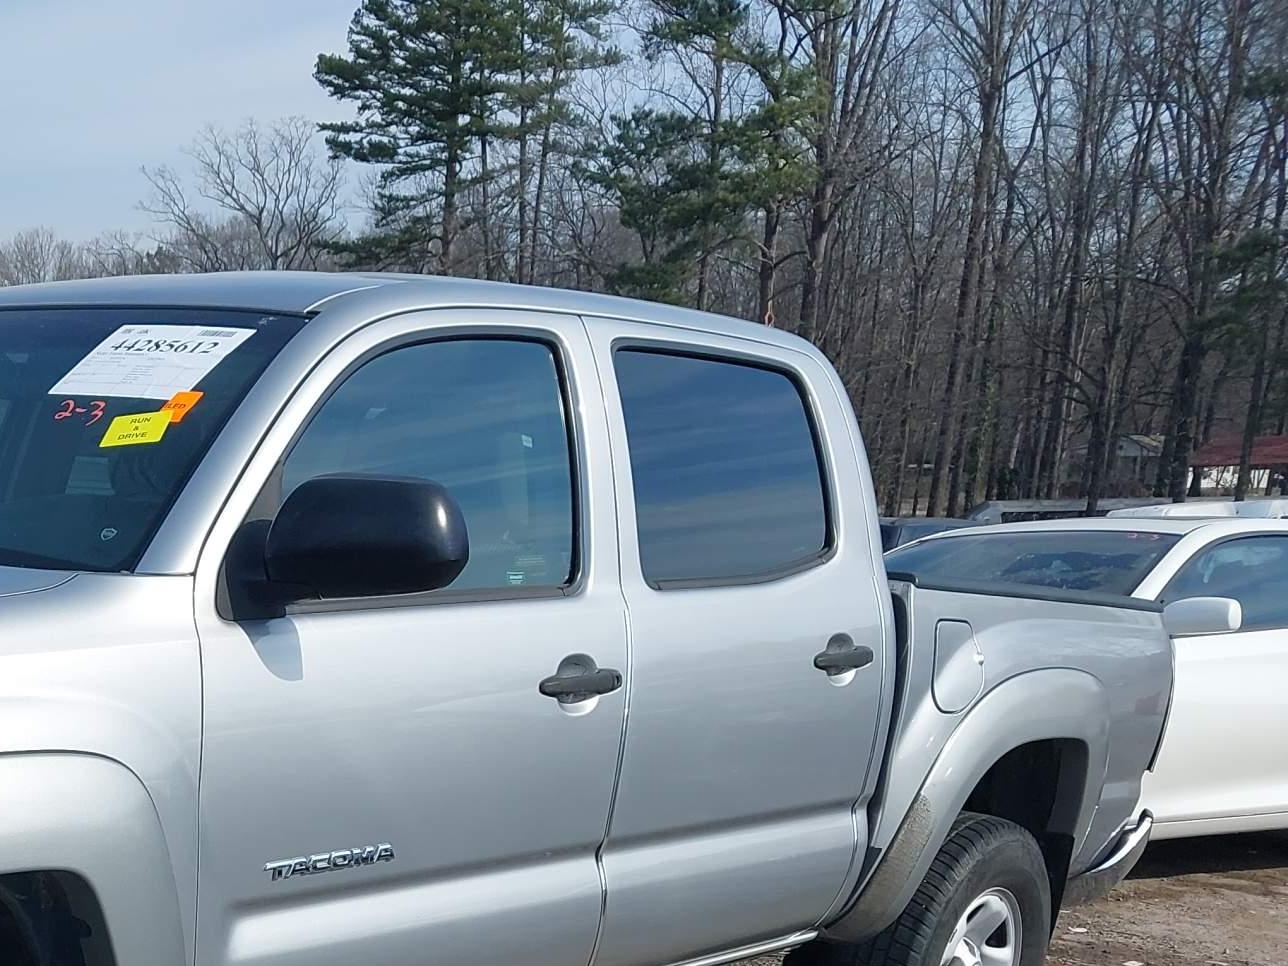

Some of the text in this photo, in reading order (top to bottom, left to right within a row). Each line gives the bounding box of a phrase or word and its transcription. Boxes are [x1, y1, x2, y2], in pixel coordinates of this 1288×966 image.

[111, 339, 219, 354] 44285612
[55, 399, 106, 426] 2-3
[130, 416, 152, 424] RUN
[117, 431, 148, 440] DRIVE
[263, 842, 396, 881] TACOMA
